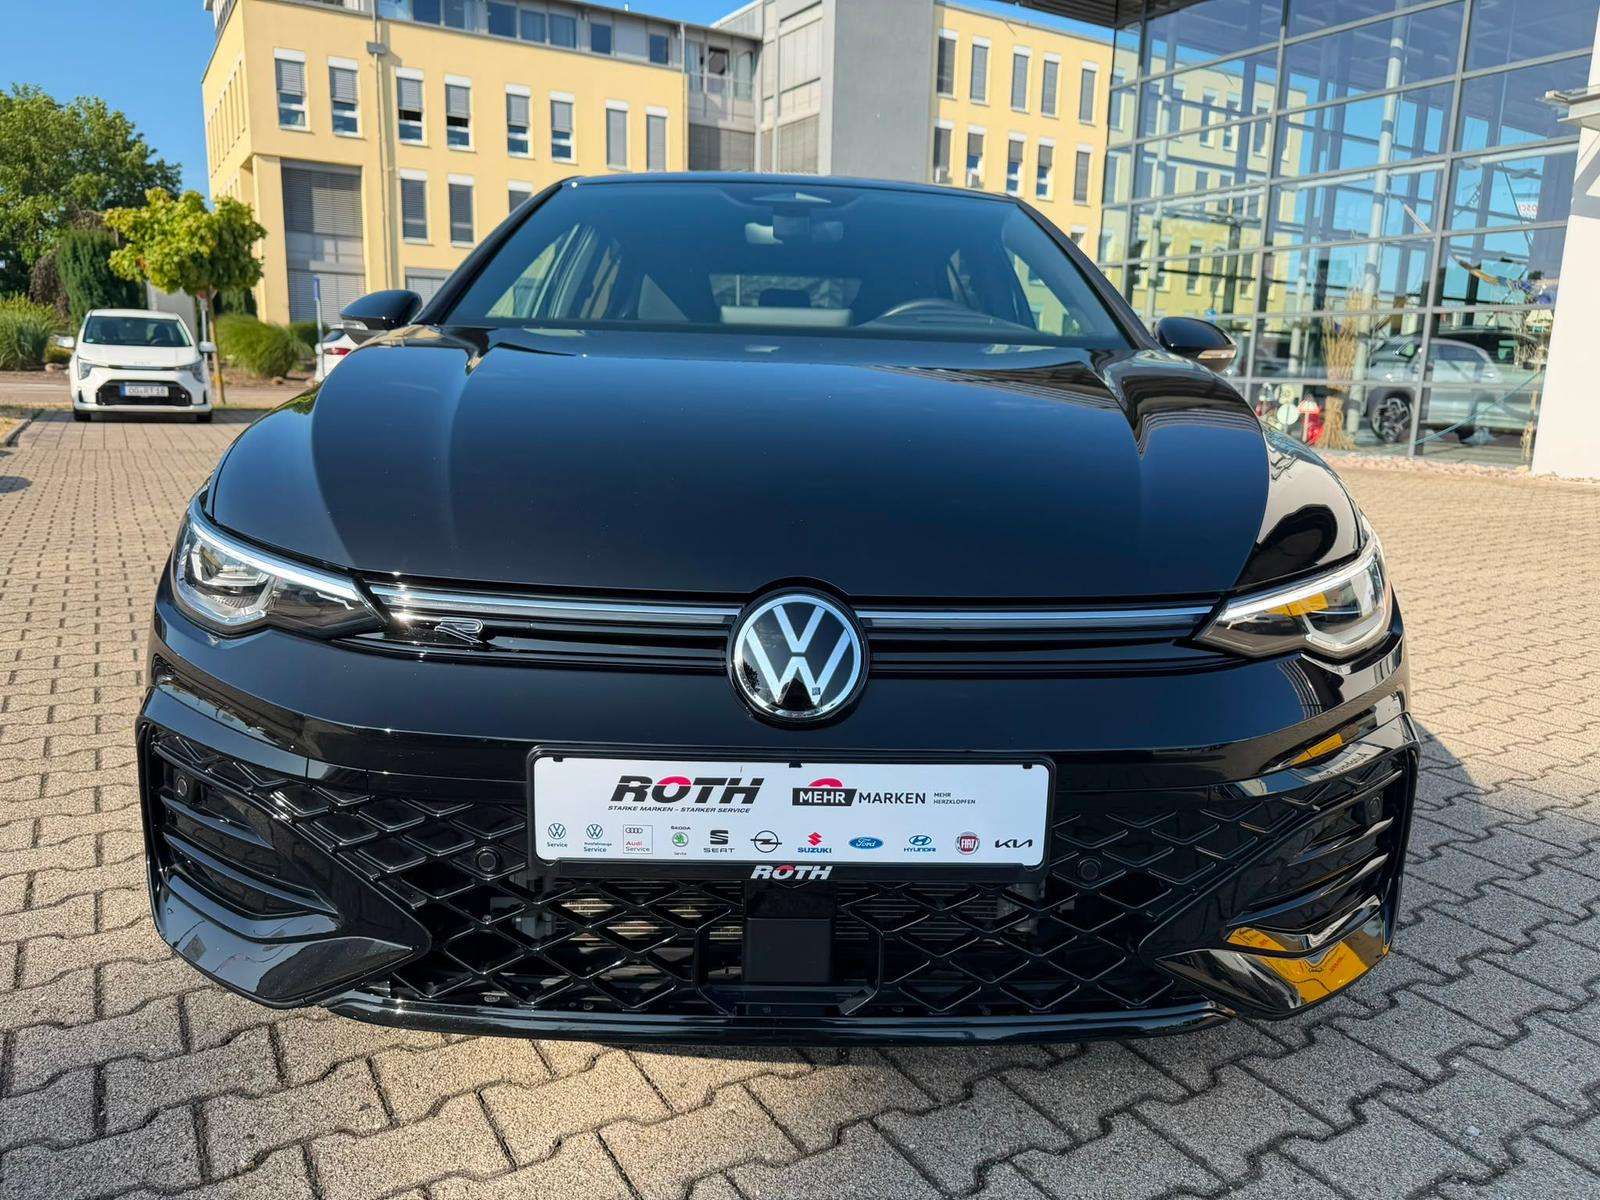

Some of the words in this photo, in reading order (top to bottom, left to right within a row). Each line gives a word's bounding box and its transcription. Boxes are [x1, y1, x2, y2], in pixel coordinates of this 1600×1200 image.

[610, 775, 765, 805] ROTH
[799, 790, 846, 804] MEHR
[858, 792, 926, 804] MARKEN
[855, 837, 877, 847] Ford
[961, 838, 976, 849] FIAT
[994, 839, 1033, 849] KIA
[750, 865, 833, 880] ROTH
